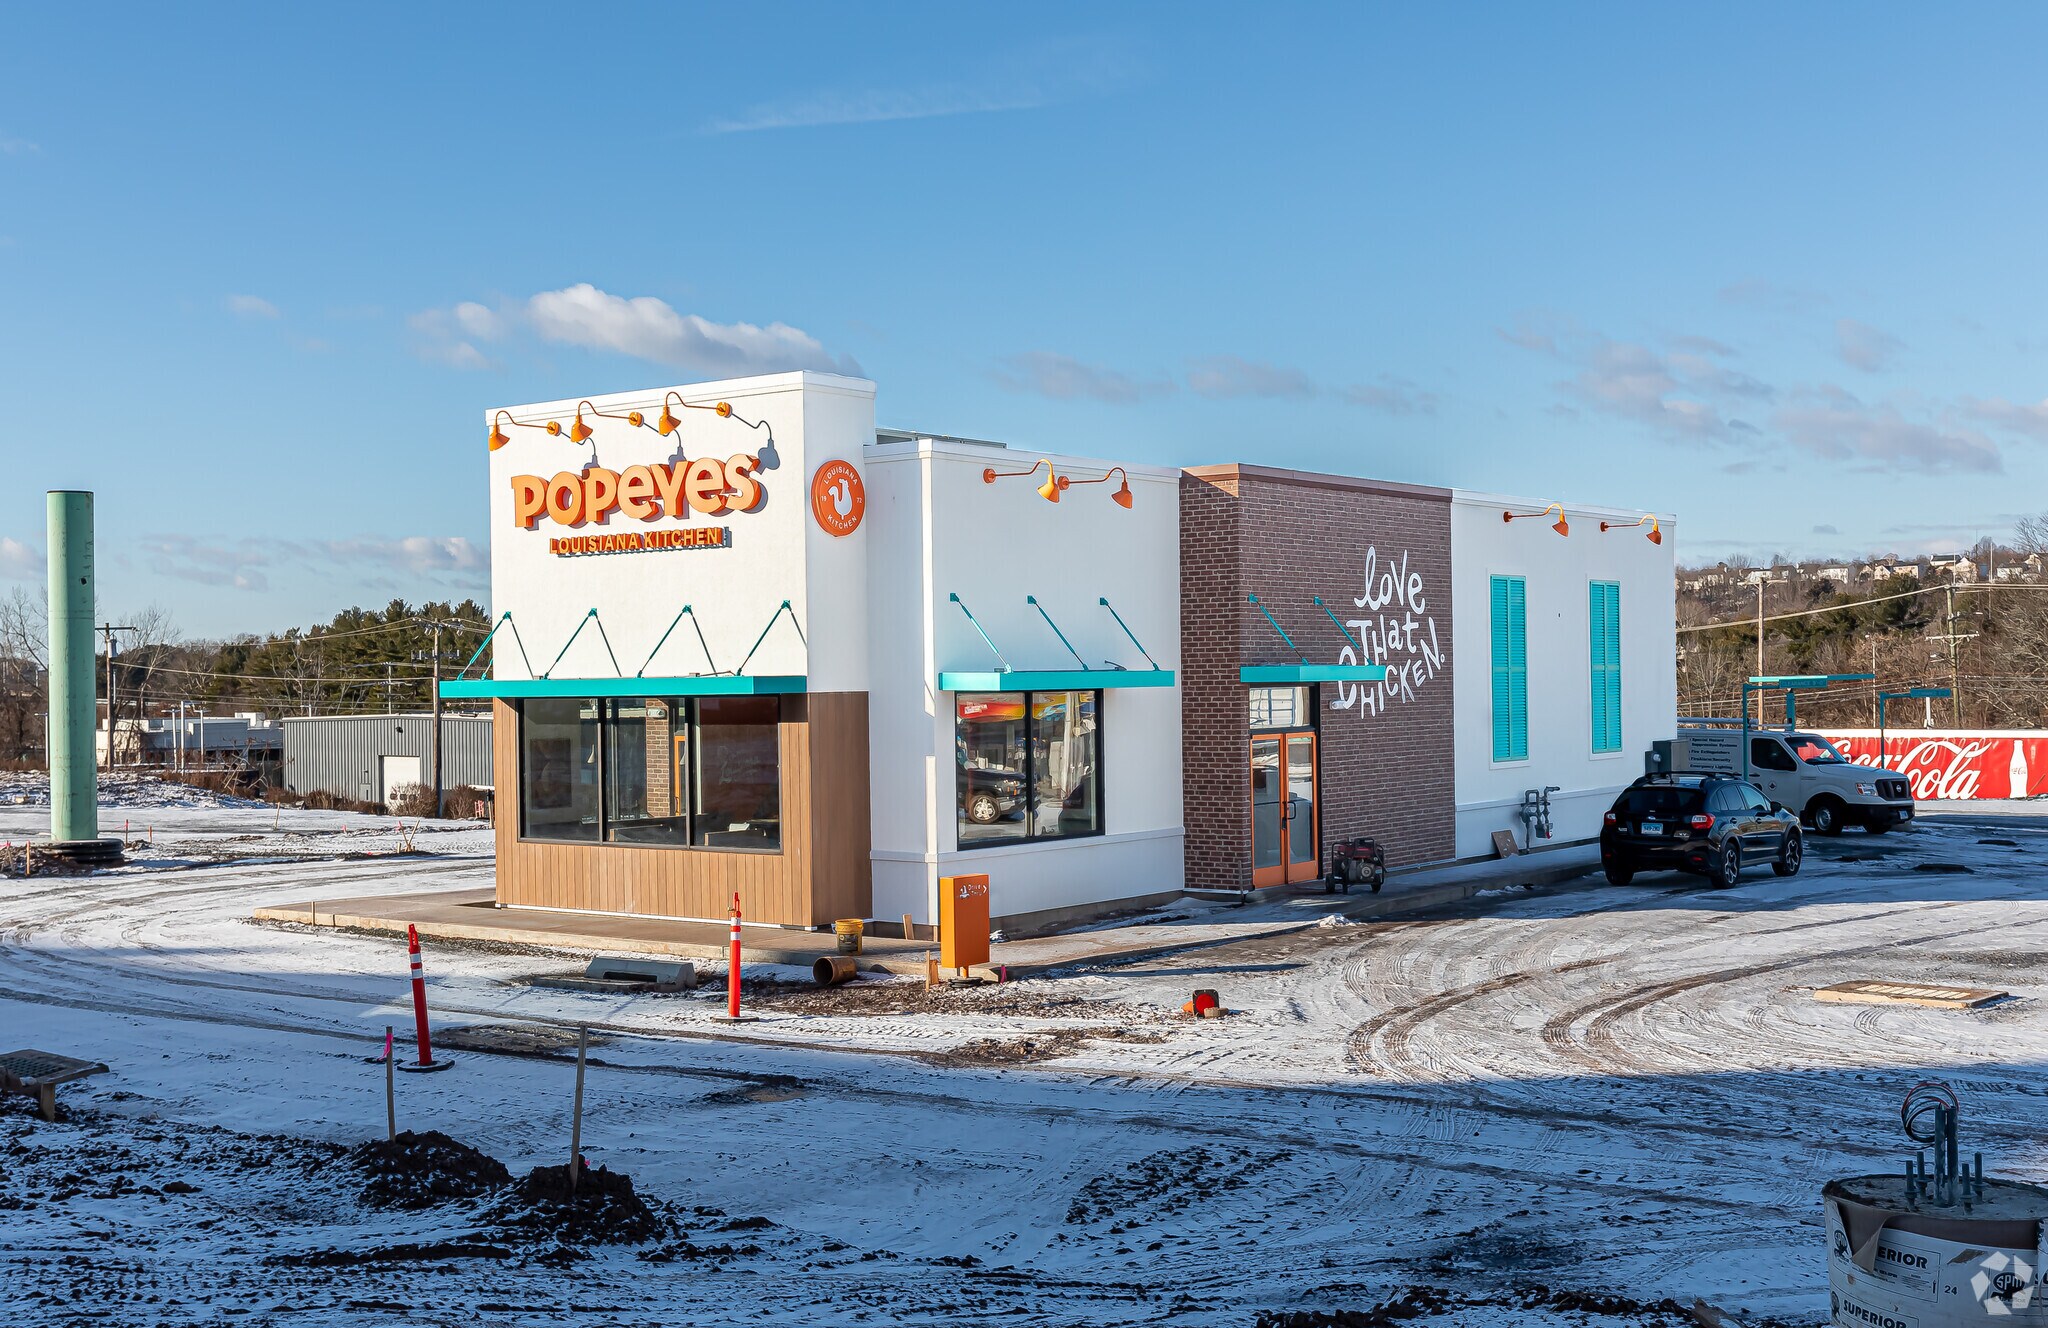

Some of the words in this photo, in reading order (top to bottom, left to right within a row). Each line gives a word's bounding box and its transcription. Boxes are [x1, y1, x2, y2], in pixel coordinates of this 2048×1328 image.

[824, 466, 858, 485] LOUISIANA
[827, 514, 858, 529] KITCHEN
[550, 533, 640, 554] LOUISIANA
[644, 527, 721, 548] KITCHEN
[1831, 740, 1992, 800] Cca-Cola
[1878, 1247, 1928, 1269] ERIOR
[1944, 1285, 1958, 1295] 24
[1843, 1299, 1907, 1328] SUPERIOR
